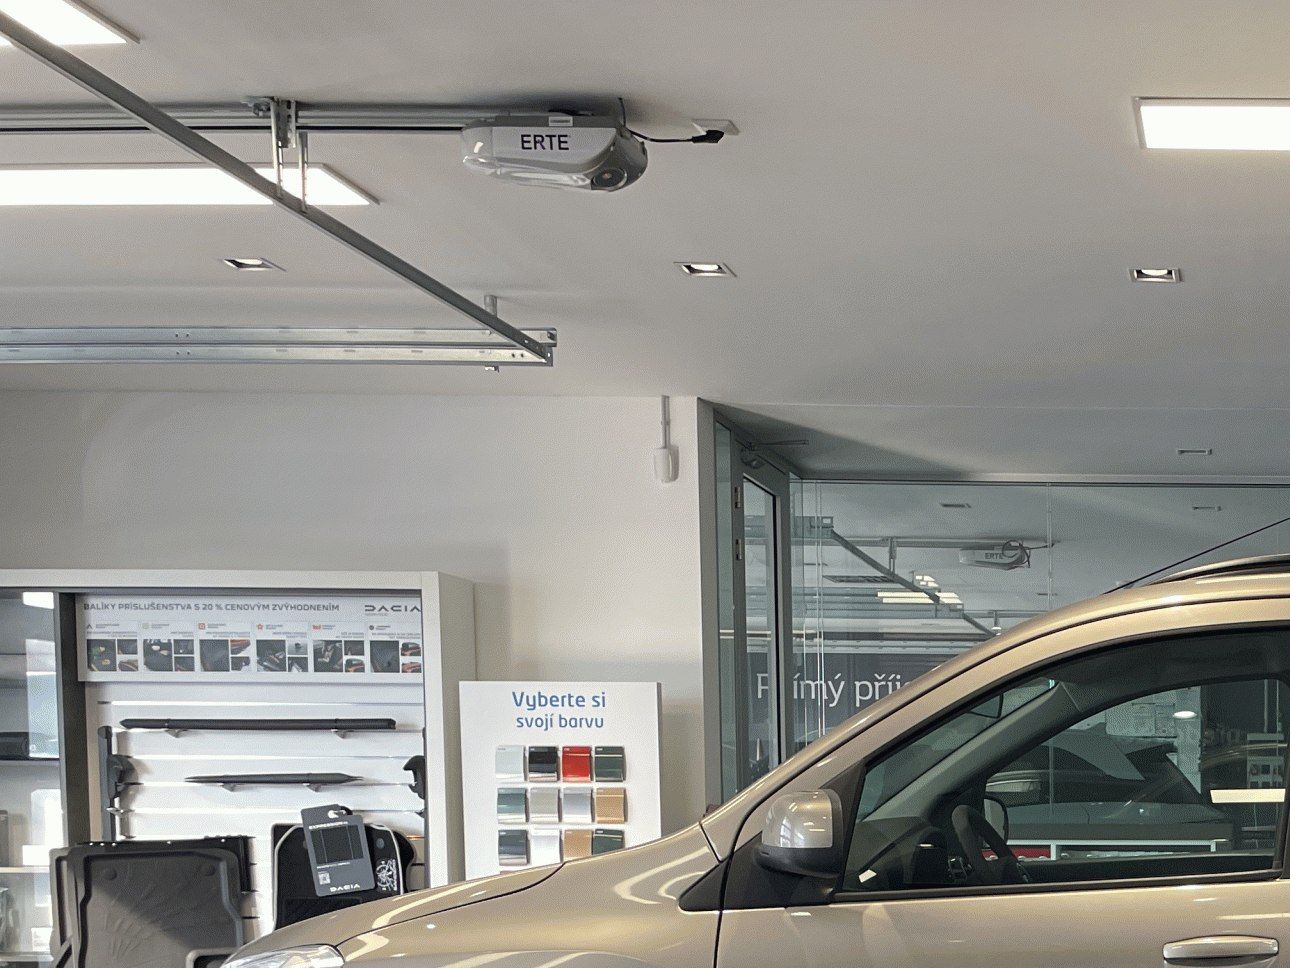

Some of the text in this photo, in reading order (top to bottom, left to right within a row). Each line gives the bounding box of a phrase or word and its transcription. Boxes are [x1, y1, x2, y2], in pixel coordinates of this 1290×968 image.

[520, 133, 570, 151] ERTE
[984, 552, 1003, 560] ERTE
[194, 603, 200, 611] S
[202, 603, 213, 611] 20
[215, 603, 223, 611] %
[225, 602, 269, 611] CENOVÝM
[364, 604, 421, 612] DACIA
[756, 673, 845, 707] Pímý
[512, 691, 606, 711] Vyberte si
[516, 713, 604, 731] svojí barvu
[329, 883, 361, 892] DACIA
